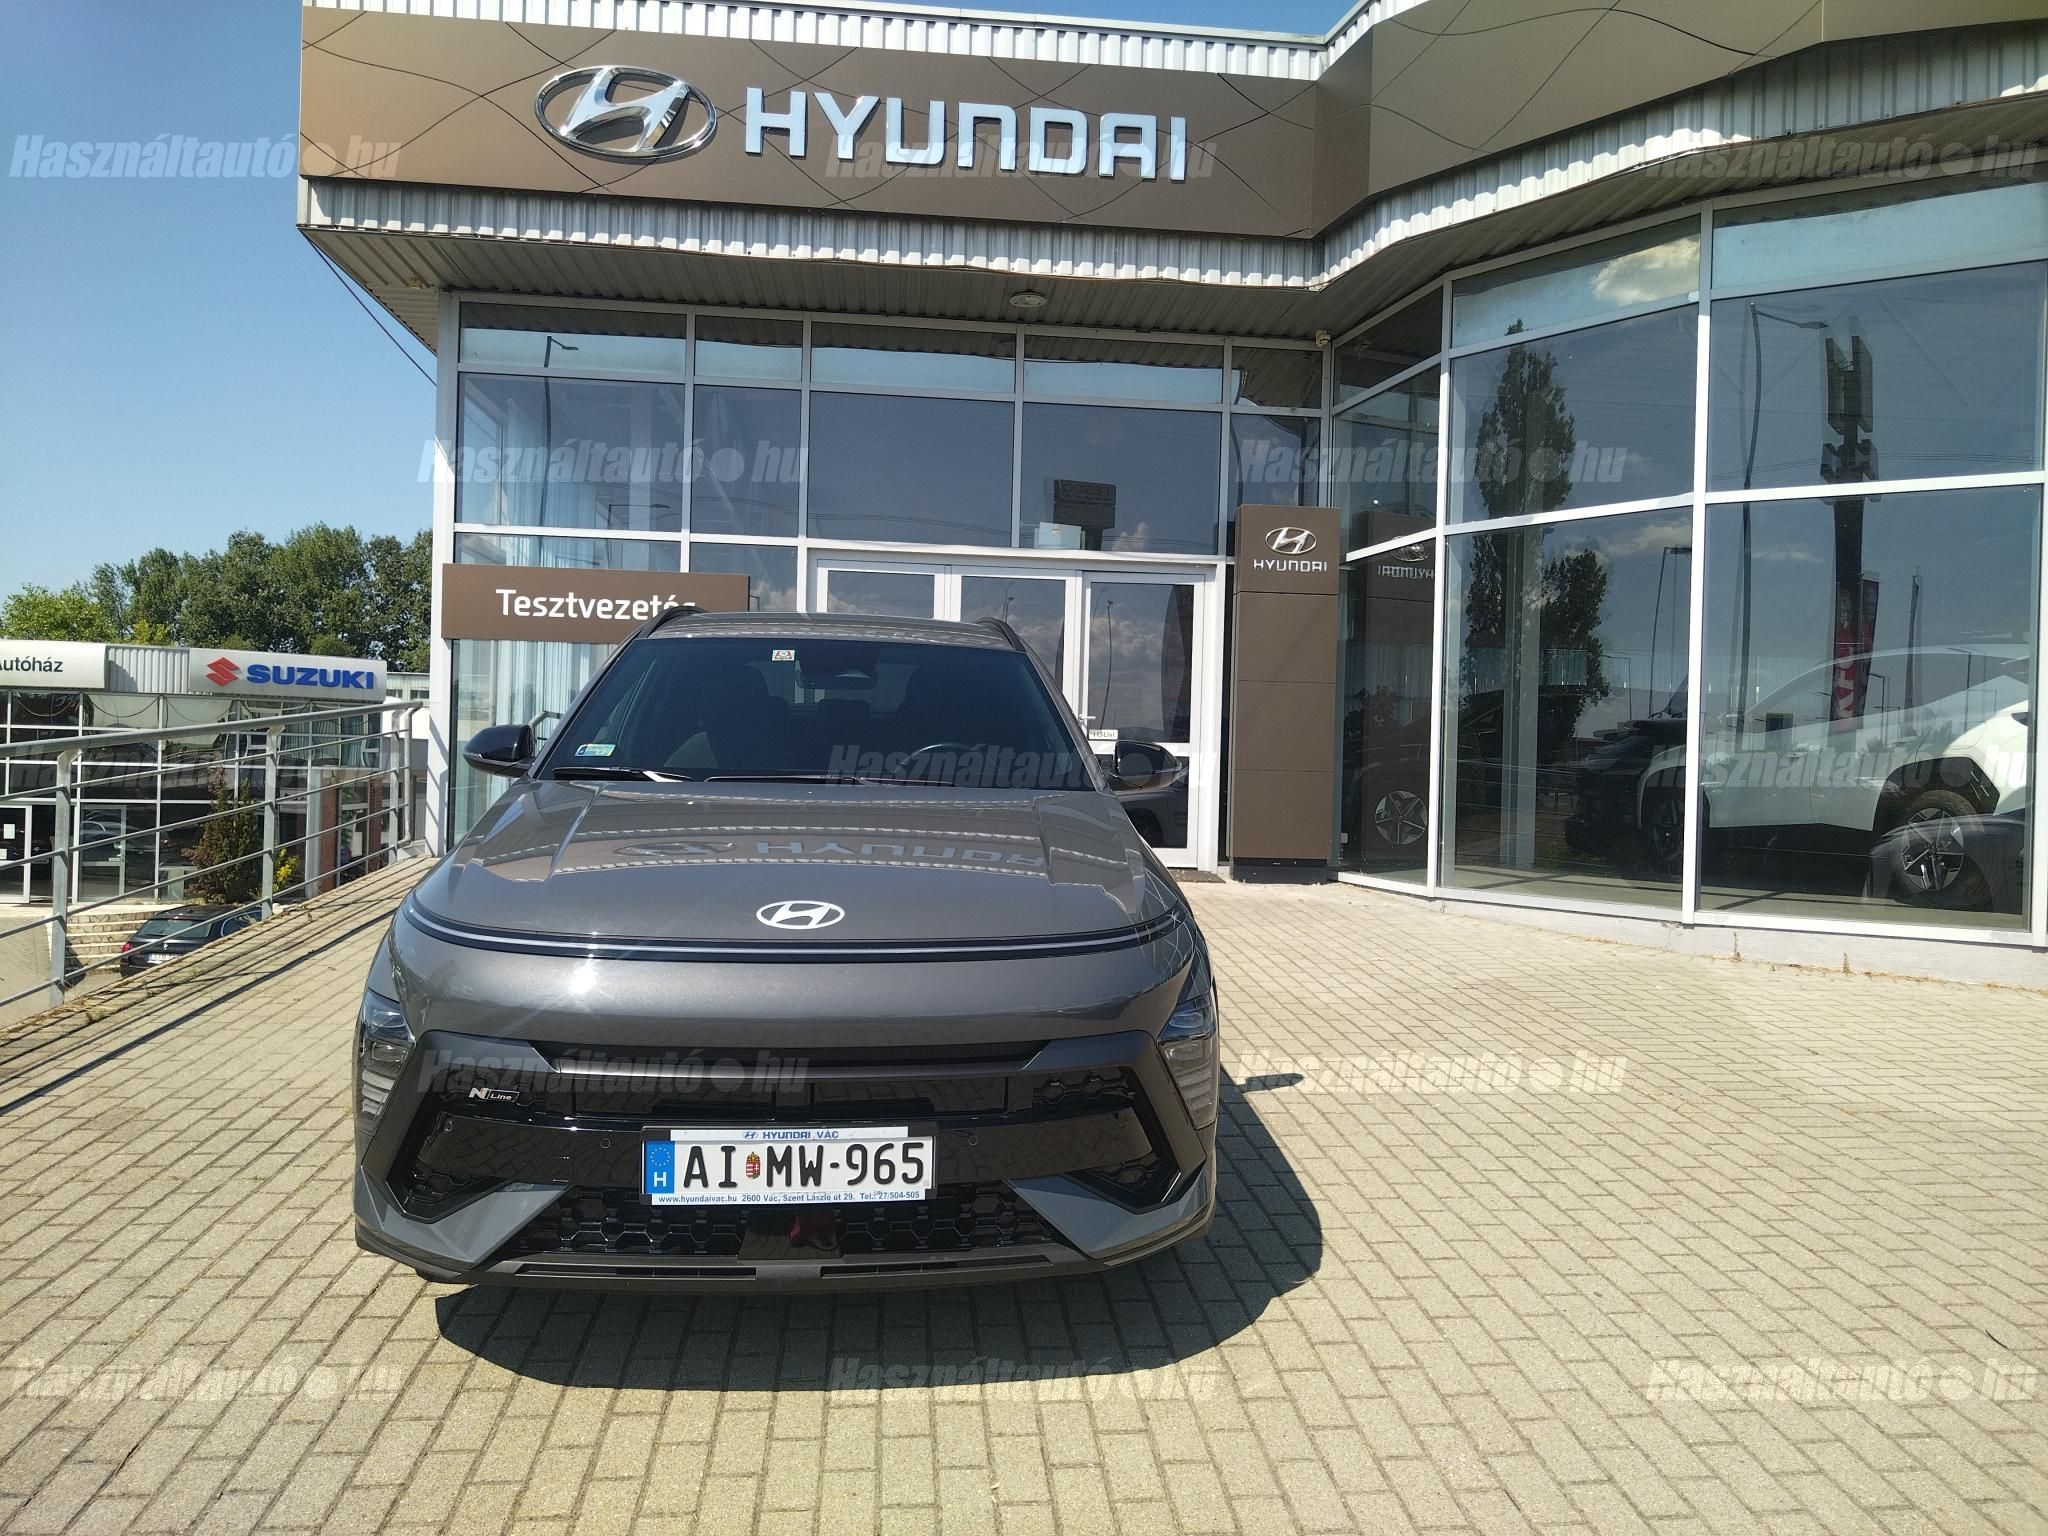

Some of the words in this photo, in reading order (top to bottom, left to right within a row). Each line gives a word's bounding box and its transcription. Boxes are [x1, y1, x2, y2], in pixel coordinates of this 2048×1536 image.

[745, 86, 1186, 182] HYUNDAI
[1253, 559, 1328, 573] HYUNDAI
[496, 589, 696, 621] Tesztvezet
[0, 656, 63, 672] utóház
[247, 664, 375, 690] SUZUKI
[763, 1131, 811, 1139] HYUNDAI
[653, 1172, 667, 1187] H
[658, 1195, 737, 1203] www.hyundaivac.hu
[742, 1194, 761, 1202] 2600
[783, 1193, 803, 1201] Szent
